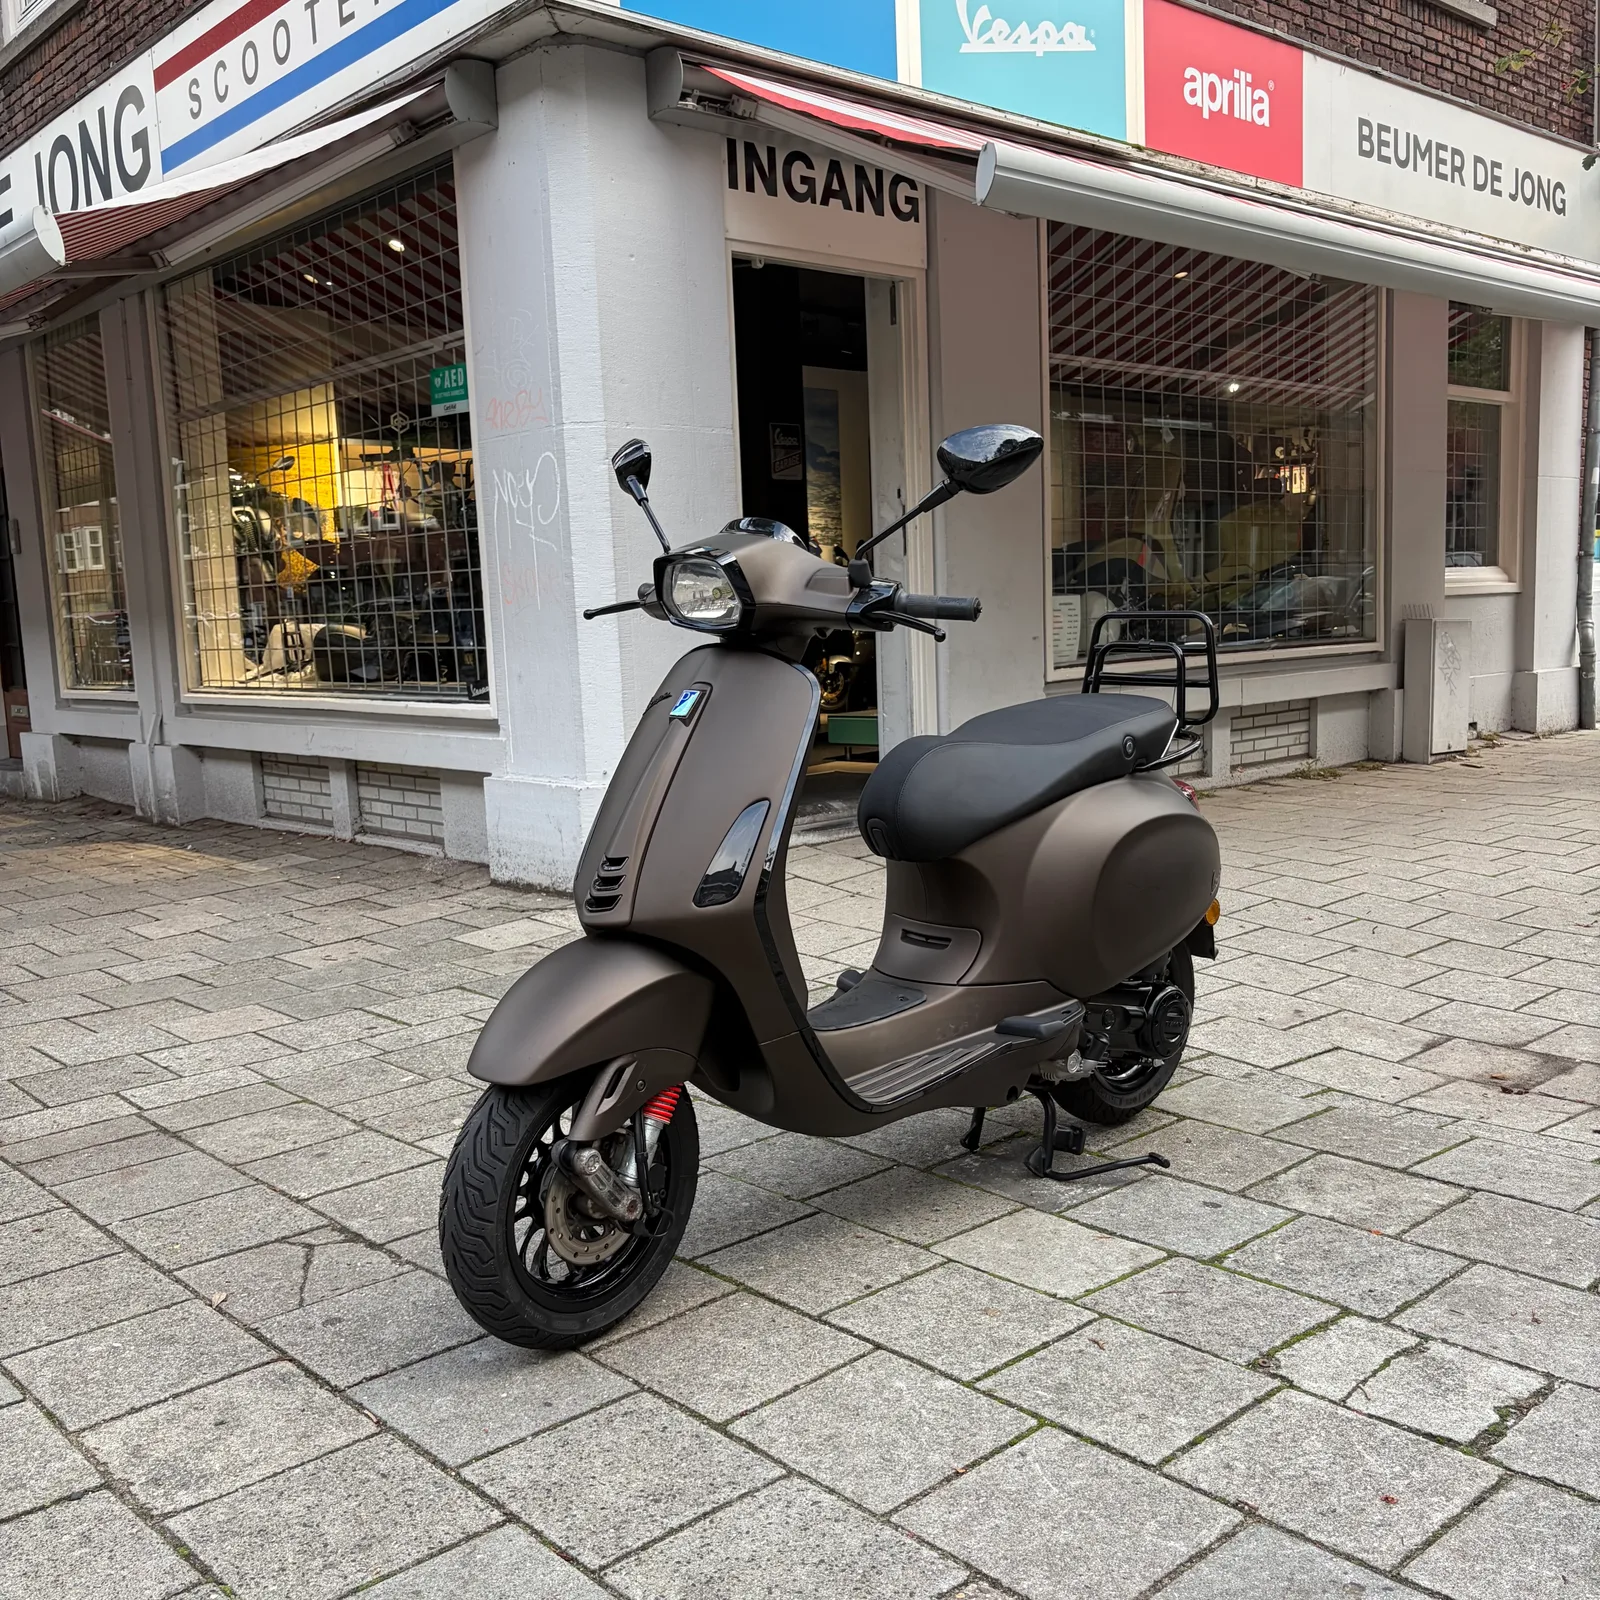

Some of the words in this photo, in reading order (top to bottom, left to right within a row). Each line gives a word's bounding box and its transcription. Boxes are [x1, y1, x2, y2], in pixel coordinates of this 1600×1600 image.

[188, 0, 380, 119] SCOOTE
[1183, 66, 1270, 127] aprilia
[726, 137, 920, 223] INGANG
[1358, 116, 1466, 187] BEUMER
[1473, 154, 1503, 198] DE
[1508, 167, 1567, 217] JONG
[444, 367, 464, 389] AED
[775, 454, 800, 472] GARAGE
